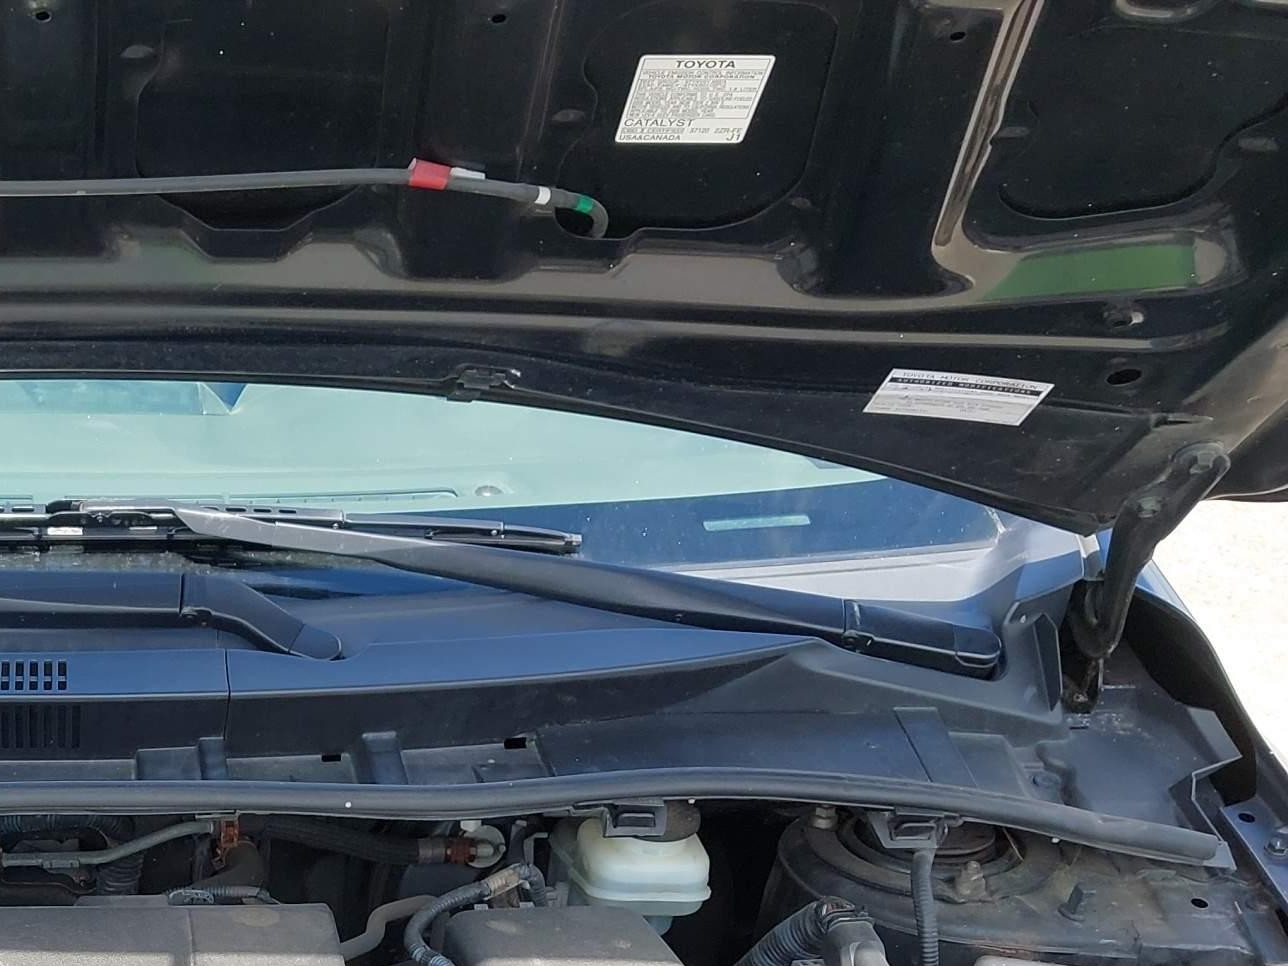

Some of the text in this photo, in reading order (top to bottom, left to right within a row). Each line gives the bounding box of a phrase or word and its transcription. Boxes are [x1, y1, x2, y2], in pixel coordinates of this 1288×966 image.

[676, 60, 736, 69] TOYOTA
[624, 118, 694, 127] CATALYST
[726, 134, 740, 142] J1
